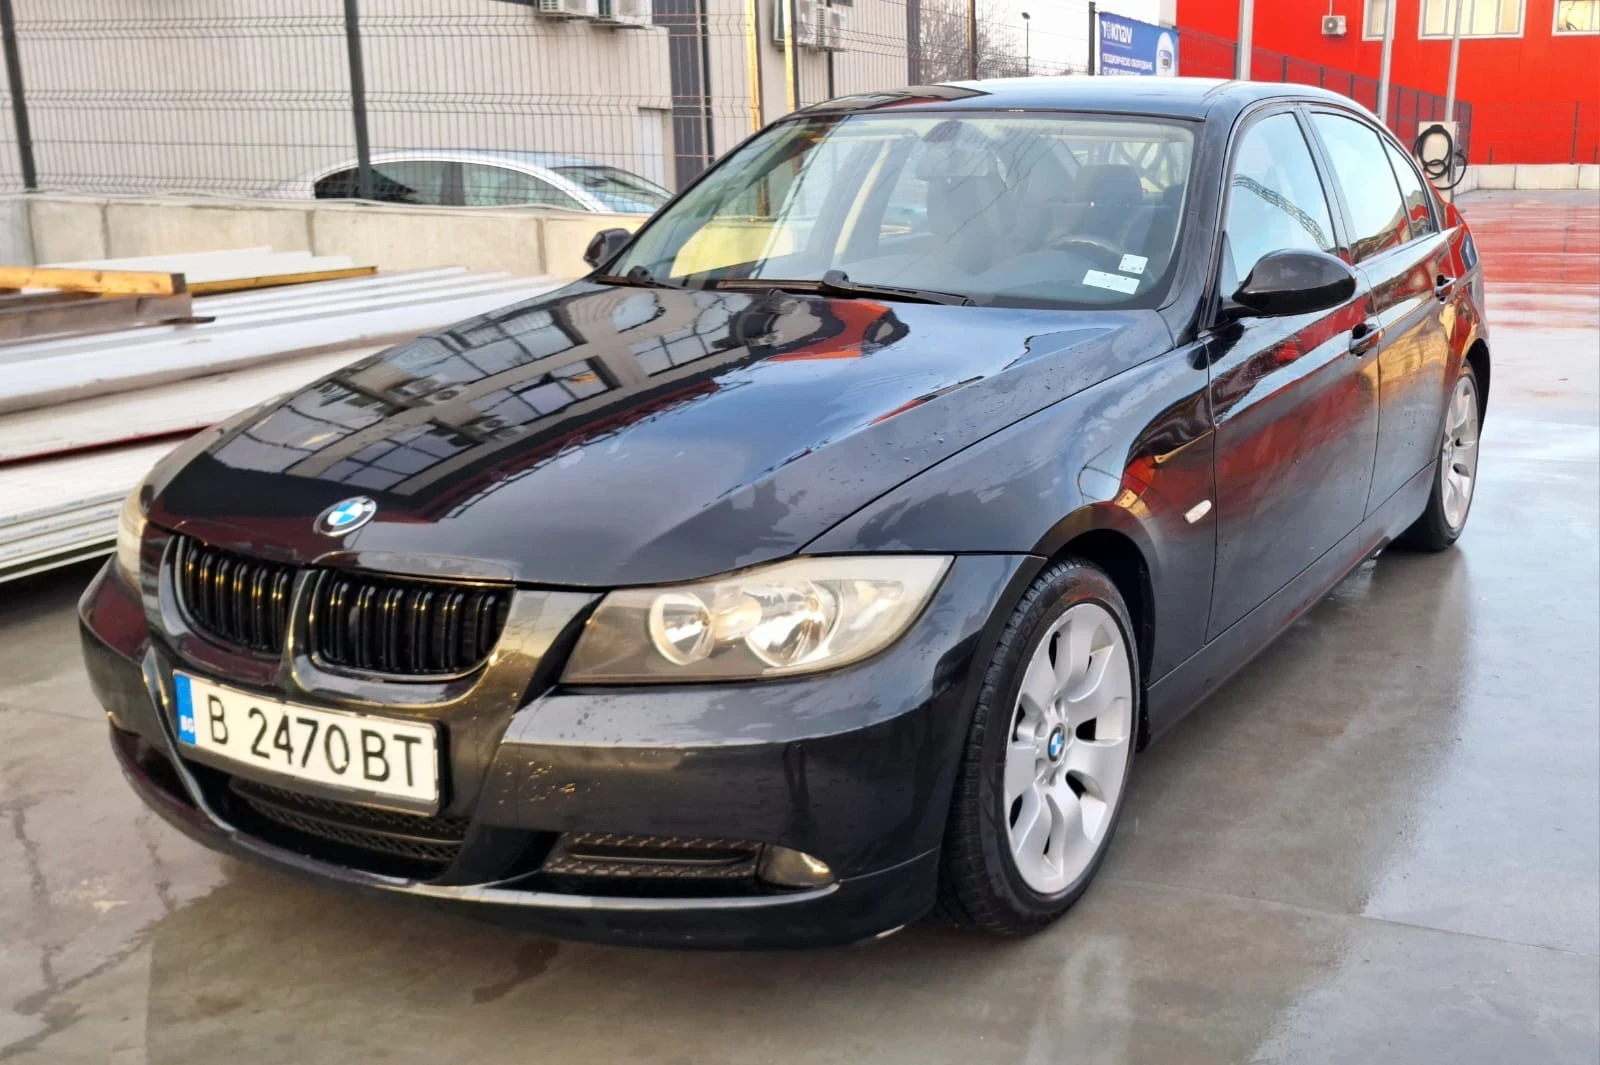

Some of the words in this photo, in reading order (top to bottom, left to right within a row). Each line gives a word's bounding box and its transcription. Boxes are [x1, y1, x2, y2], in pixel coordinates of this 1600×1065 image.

[207, 694, 229, 745] B
[248, 707, 350, 774] 2470
[361, 729, 421, 786] BT
